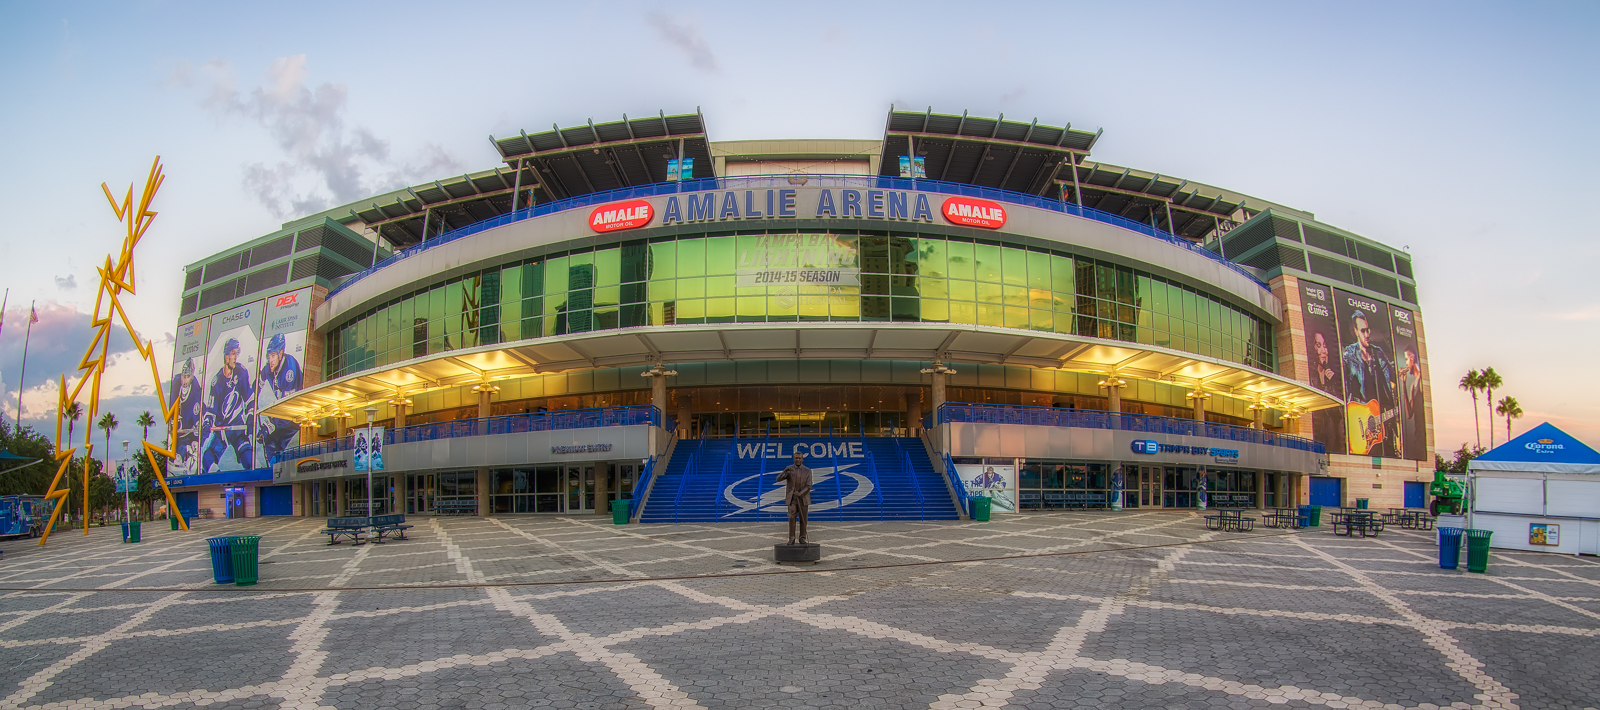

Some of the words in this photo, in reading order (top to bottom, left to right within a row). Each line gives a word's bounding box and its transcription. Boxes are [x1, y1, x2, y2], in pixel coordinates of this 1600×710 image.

[662, 189, 797, 225] AMALIE
[815, 188, 934, 222] ARENA
[948, 202, 1003, 222] AMALIE
[592, 205, 649, 225] AMALIE
[605, 222, 624, 230] MOTOR
[754, 234, 803, 248] TAMPA
[807, 233, 840, 247] BAY
[738, 248, 857, 267] LIGHTNING
[754, 270, 798, 284] 2014-15
[799, 270, 841, 283] SEASON
[800, 286, 843, 295] FLORIDA
[275, 293, 299, 308] DEX
[1347, 298, 1371, 311] CHASE
[222, 311, 244, 325] CHASE
[1394, 309, 1409, 320] DEX
[736, 441, 865, 459] WELCOME
[1159, 443, 1190, 454] TAMPA
[1191, 446, 1208, 455] BAY
[1209, 447, 1239, 458] SPORTS
[1524, 442, 1564, 451] Corona
